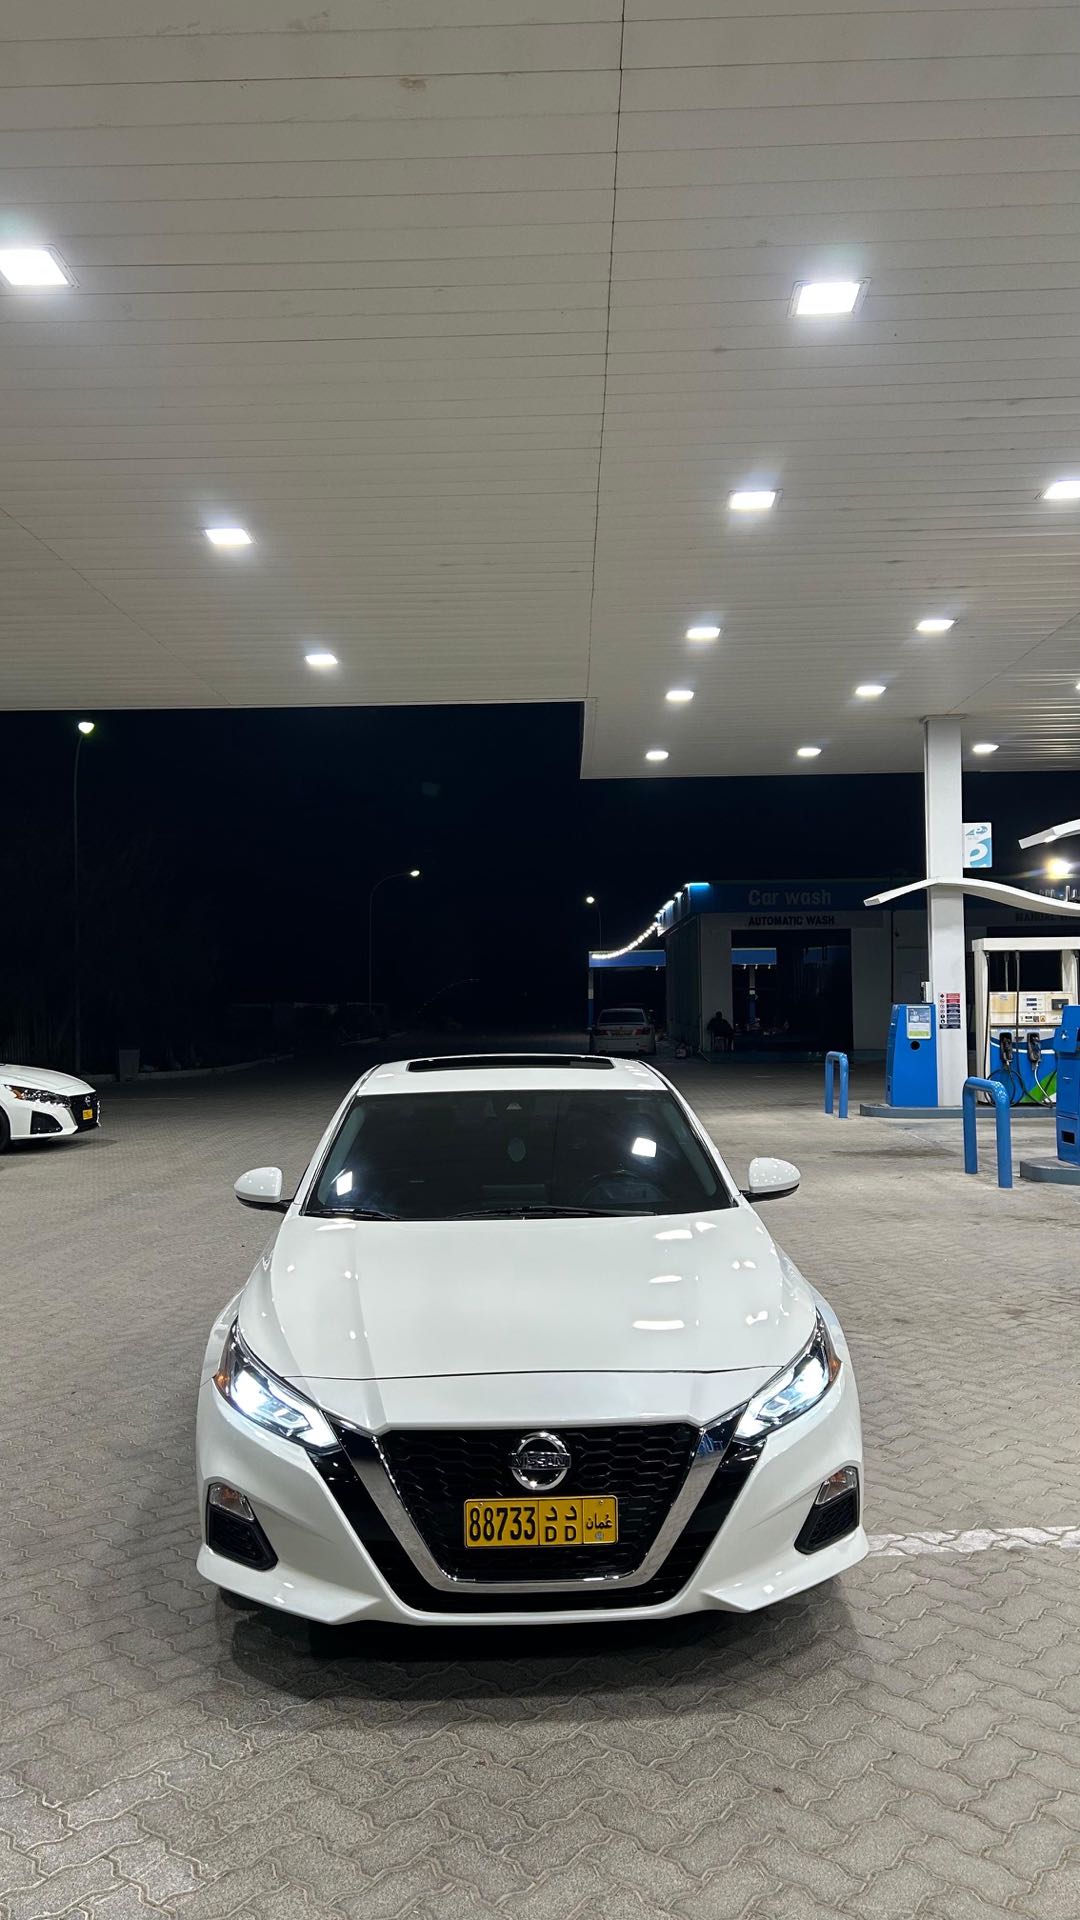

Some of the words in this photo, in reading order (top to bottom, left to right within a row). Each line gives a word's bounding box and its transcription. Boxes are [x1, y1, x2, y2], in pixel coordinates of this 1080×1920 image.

[748, 889, 780, 905] Car
[784, 889, 832, 905] wash
[749, 916, 803, 926] AUTOMATIC
[806, 915, 834, 925] WASH
[511, 1453, 565, 1466] NISSAN
[469, 1507, 536, 1541] 88733
